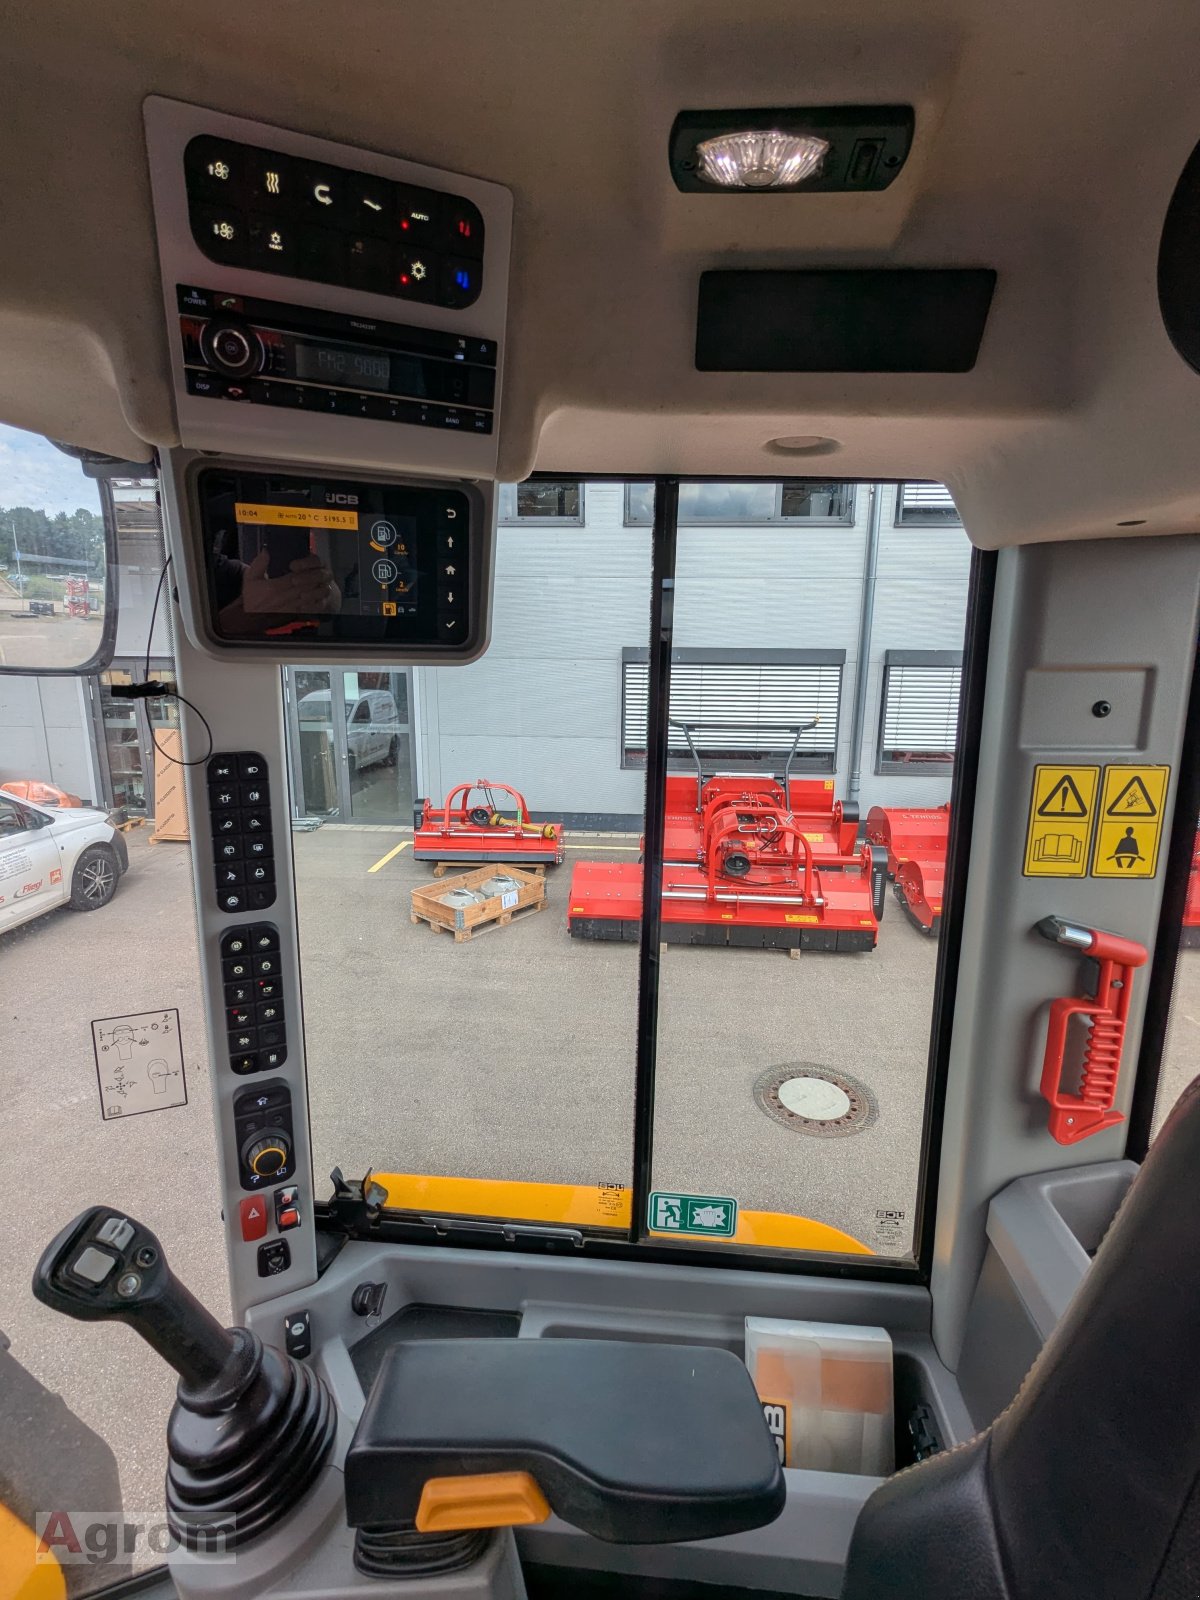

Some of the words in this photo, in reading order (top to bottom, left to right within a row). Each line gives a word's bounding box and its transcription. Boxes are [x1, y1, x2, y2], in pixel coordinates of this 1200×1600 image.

[411, 212, 429, 221] AUTO
[184, 297, 207, 306] POWER
[195, 382, 210, 390] DISP
[325, 493, 359, 504] JCB
[238, 509, 258, 517] 10:04
